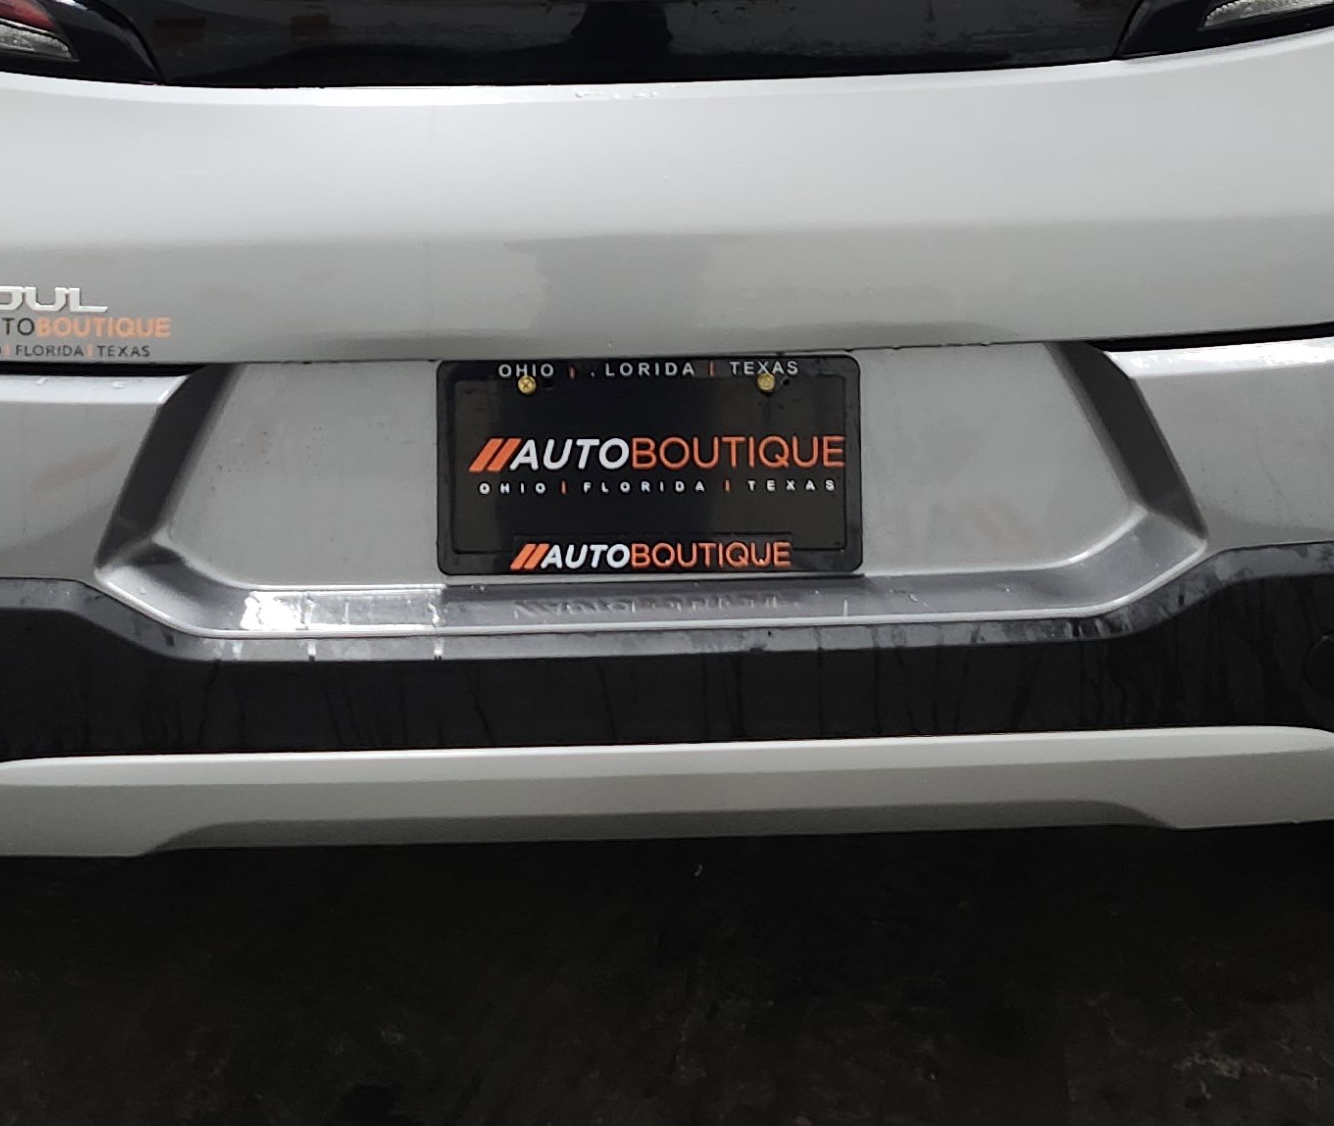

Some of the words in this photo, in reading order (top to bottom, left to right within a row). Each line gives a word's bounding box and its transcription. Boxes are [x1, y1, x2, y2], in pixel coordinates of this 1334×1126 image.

[15, 344, 84, 358] FLORIDA
[97, 345, 151, 358] TEXAS
[498, 363, 554, 378] OHIO
[590, 361, 696, 377] LORIDA
[729, 360, 799, 376] TEXAS
[509, 435, 846, 471] AUTOBOUTIQUE
[479, 481, 547, 495] OHIO
[583, 480, 706, 494] FLORIDA
[748, 479, 836, 492] TEXAS
[540, 541, 793, 570] AUTOBOUTIQUE
